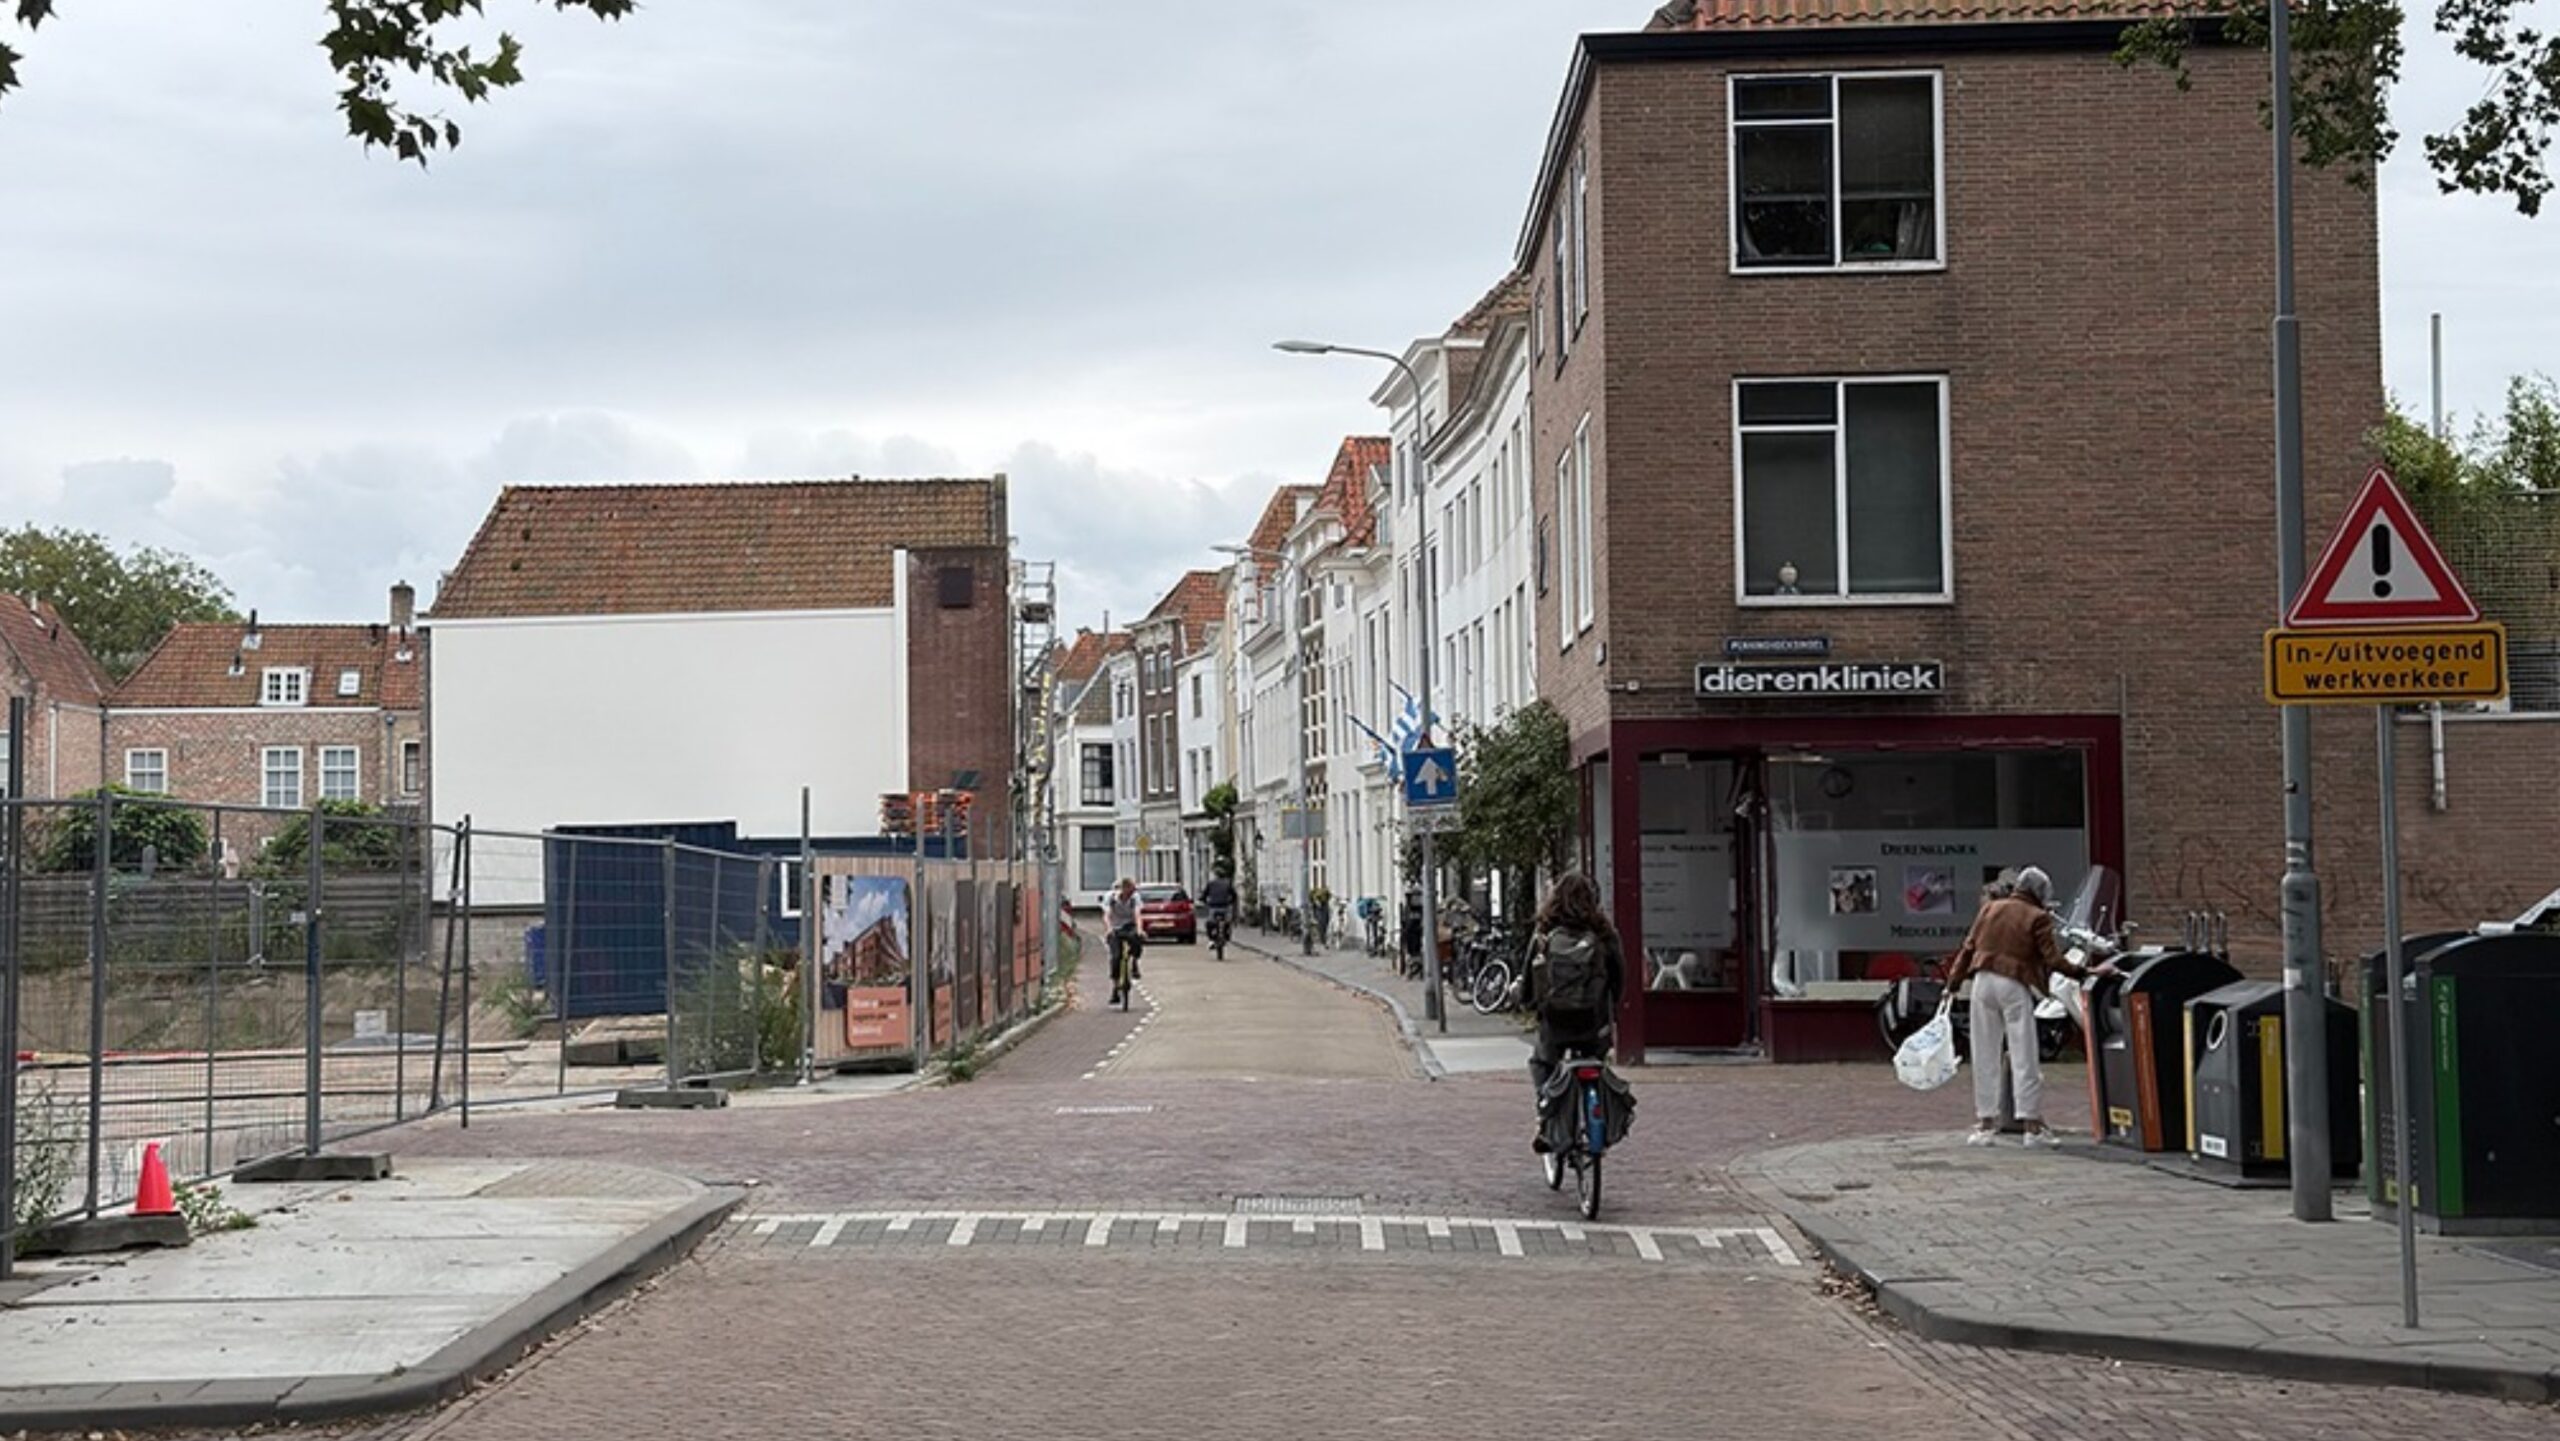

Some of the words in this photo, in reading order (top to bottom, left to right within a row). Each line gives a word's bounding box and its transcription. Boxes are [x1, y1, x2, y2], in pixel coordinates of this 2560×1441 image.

[2285, 640, 2486, 666] In-/uitvoegend
[1702, 665, 1937, 692] dierenkliniek
[2303, 668, 2470, 690] werkverkeer
